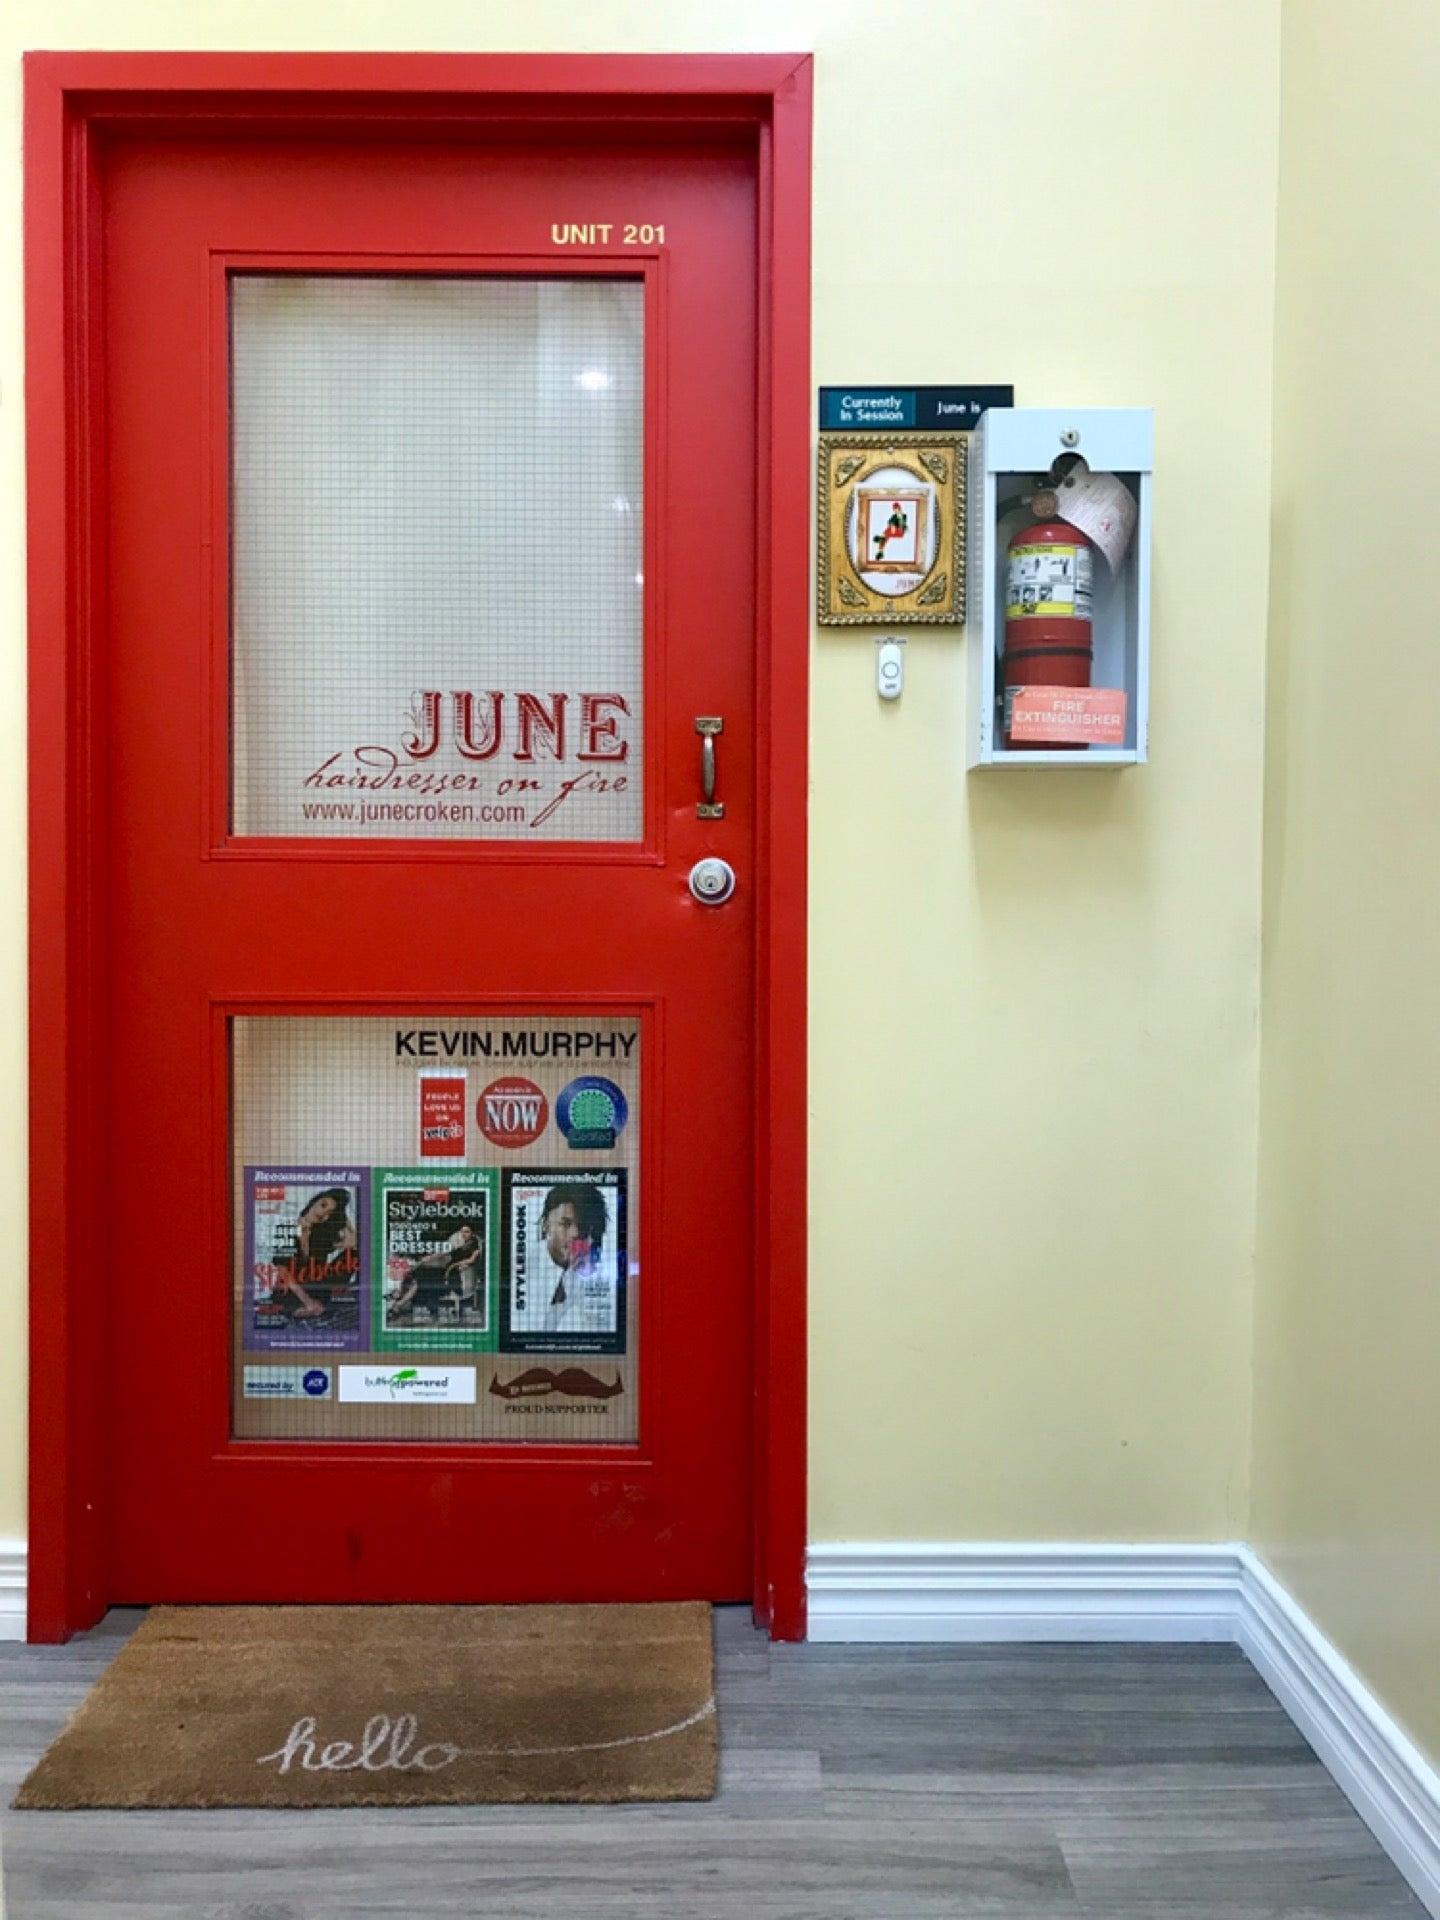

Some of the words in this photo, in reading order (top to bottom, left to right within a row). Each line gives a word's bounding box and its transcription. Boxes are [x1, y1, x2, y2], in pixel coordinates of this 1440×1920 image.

[551, 224, 613, 245] UNIT
[623, 224, 665, 245] 201
[842, 395, 903, 410] Currently
[936, 401, 966, 416] June
[971, 401, 981, 414] is
[840, 409, 851, 421] In
[857, 409, 904, 421] Session
[1053, 700, 1086, 712] FIRE
[400, 689, 631, 763] JUNE
[1014, 711, 1121, 726] EXTINGUISHER
[303, 746, 483, 795] hairdresser
[497, 777, 543, 796] on
[530, 769, 629, 828] fire
[302, 801, 525, 824] www.junecroken.com
[396, 1030, 638, 1058] KEVIN.MURPHY
[485, 1099, 541, 1132] NOW
[511, 1172, 603, 1184] Recommended
[389, 1201, 483, 1220] Stylebook
[390, 1230, 422, 1241] BEST
[390, 1241, 452, 1254] DRESSED
[516, 1205, 527, 1311] STYLEBOOK
[505, 1405, 543, 1414] PROUD
[544, 1405, 609, 1414] SUPPORTER
[257, 1713, 462, 1775] hello
